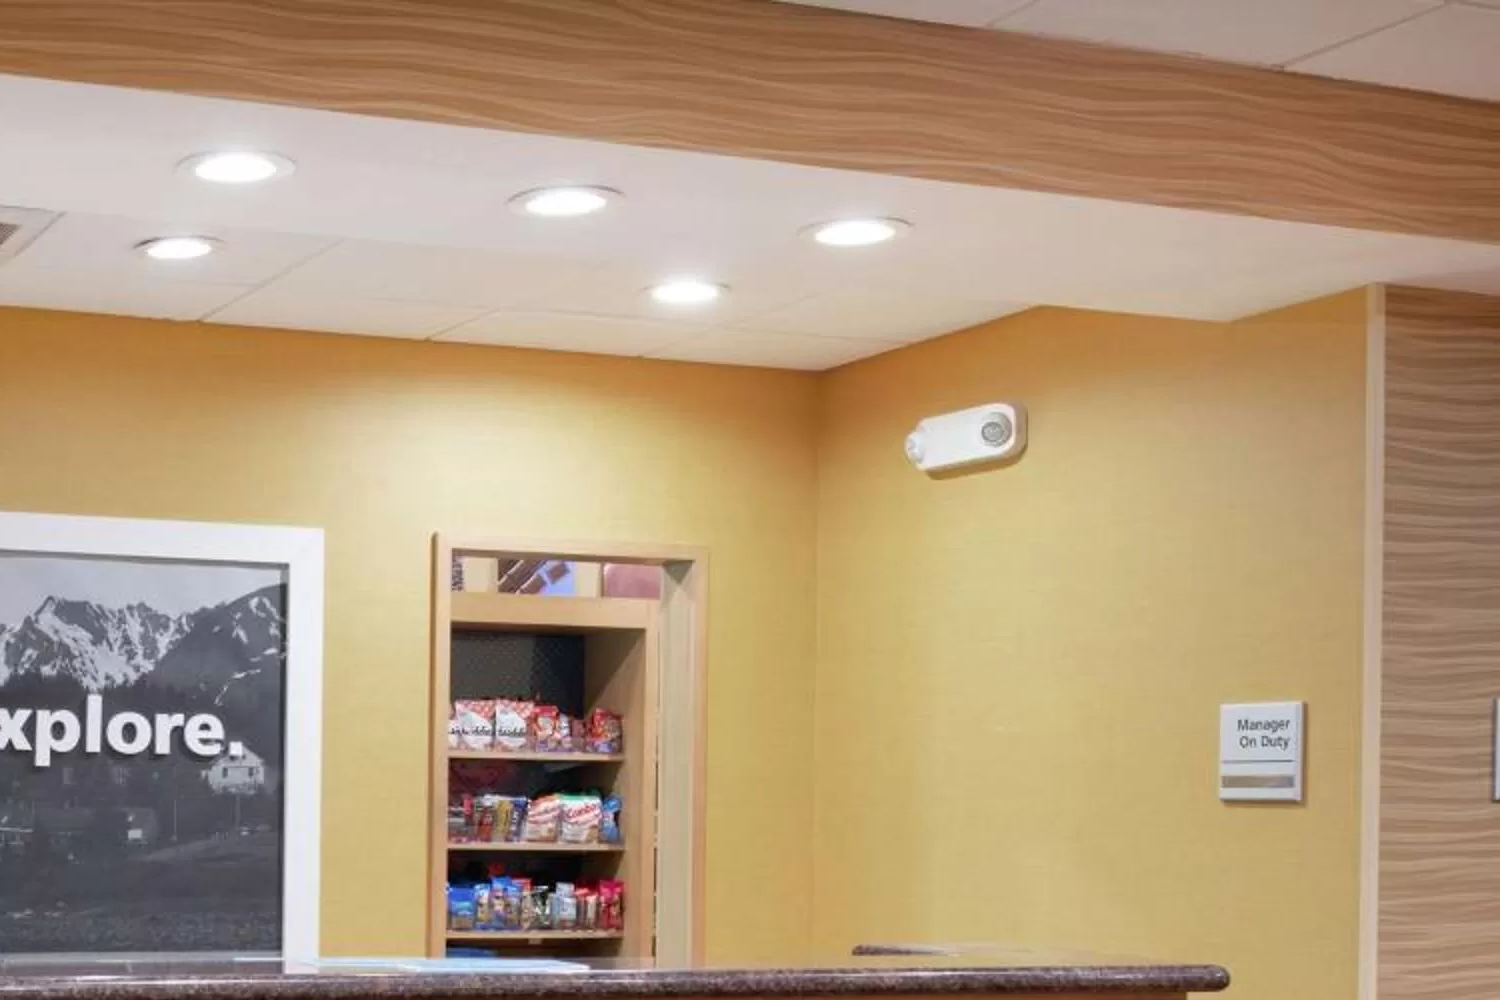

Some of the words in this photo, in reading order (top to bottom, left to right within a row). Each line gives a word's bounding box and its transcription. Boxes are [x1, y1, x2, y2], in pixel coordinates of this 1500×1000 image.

[1237, 719, 1291, 733] Manager
[1239, 736, 1257, 748] On
[1261, 735, 1291, 751] Duty
